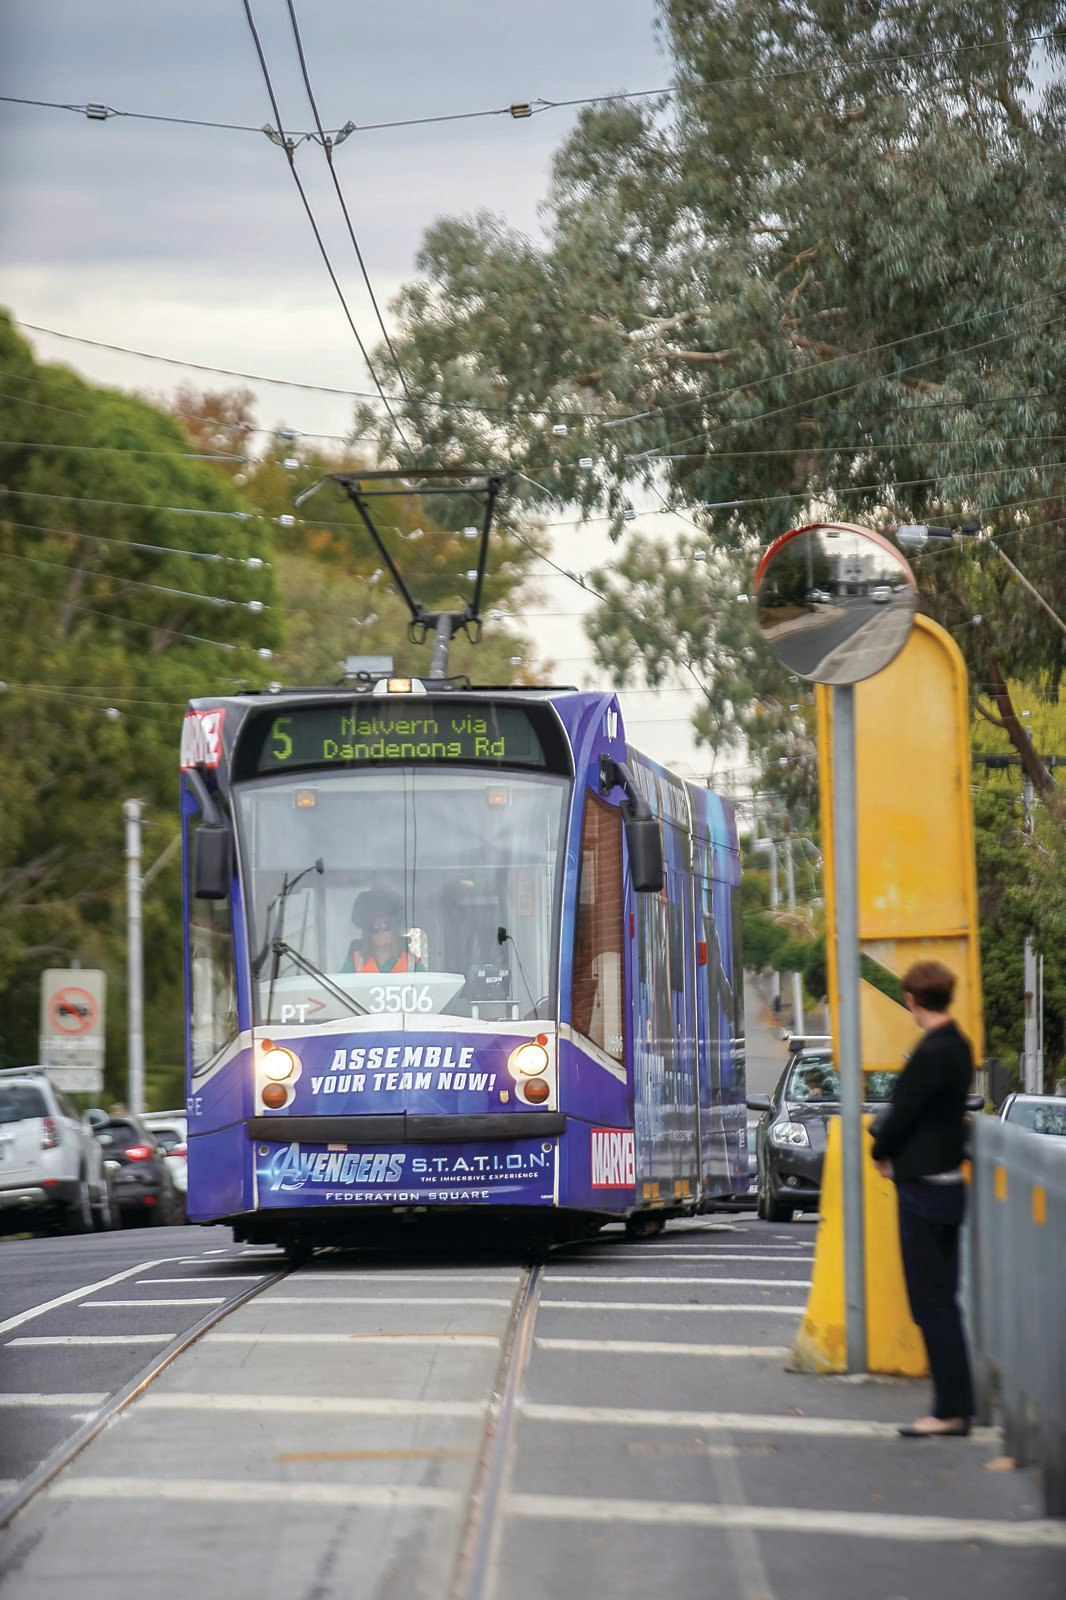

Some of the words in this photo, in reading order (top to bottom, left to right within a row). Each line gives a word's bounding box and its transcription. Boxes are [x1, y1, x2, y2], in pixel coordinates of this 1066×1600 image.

[451, 714, 487, 734] via
[272, 717, 293, 760] 5
[324, 738, 462, 759] Dandenong
[475, 736, 505, 757] Rd
[369, 985, 433, 1014] 3506
[330, 1046, 475, 1071] ASSEMBLE
[310, 1074, 366, 1095] YOUR
[372, 1072, 431, 1092] TEAM
[437, 1072, 497, 1092] NOW!
[270, 1142, 406, 1191] AVENGERS
[440, 1174, 486, 1182] IMMERSIVE
[489, 1171, 539, 1181] EXPERIENCE
[326, 1191, 420, 1201] FEDERATION
[428, 1190, 490, 1201] SQUARE
